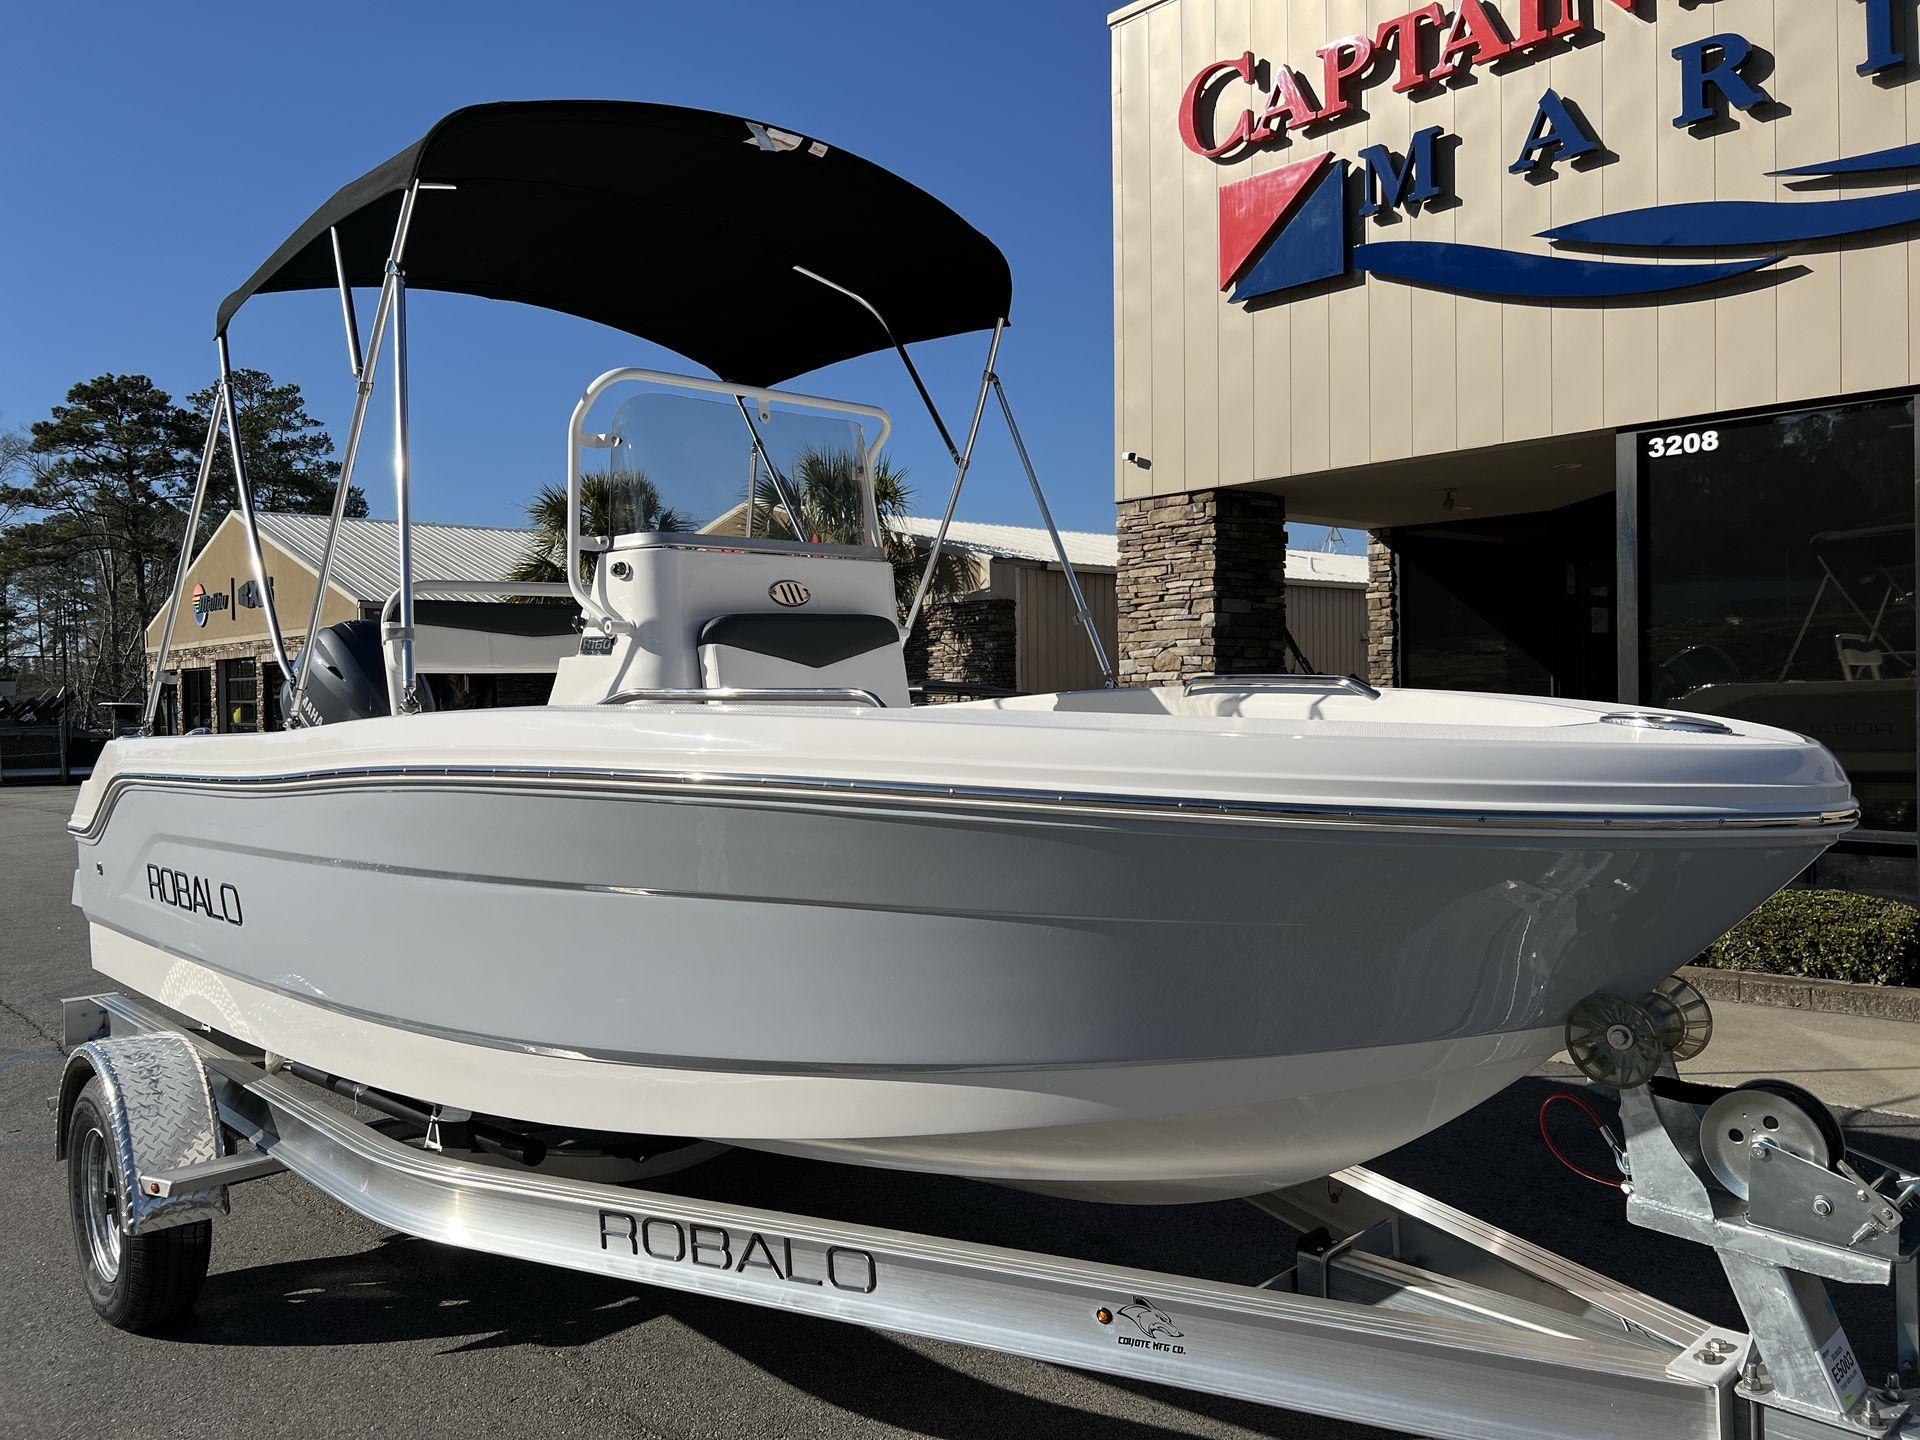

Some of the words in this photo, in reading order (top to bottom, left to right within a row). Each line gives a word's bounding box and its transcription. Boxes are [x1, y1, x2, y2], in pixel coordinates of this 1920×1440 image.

[1648, 430, 1719, 458] 3208
[199, 592, 229, 614] Malibu
[147, 863, 243, 927] ROBALO
[599, 1209, 877, 1294] ROBALO
[1118, 1336, 1151, 1349] COYOTE
[1152, 1341, 1171, 1353] MFG
[1172, 1345, 1187, 1355] CO.
[1831, 1350, 1854, 1384] E5003
